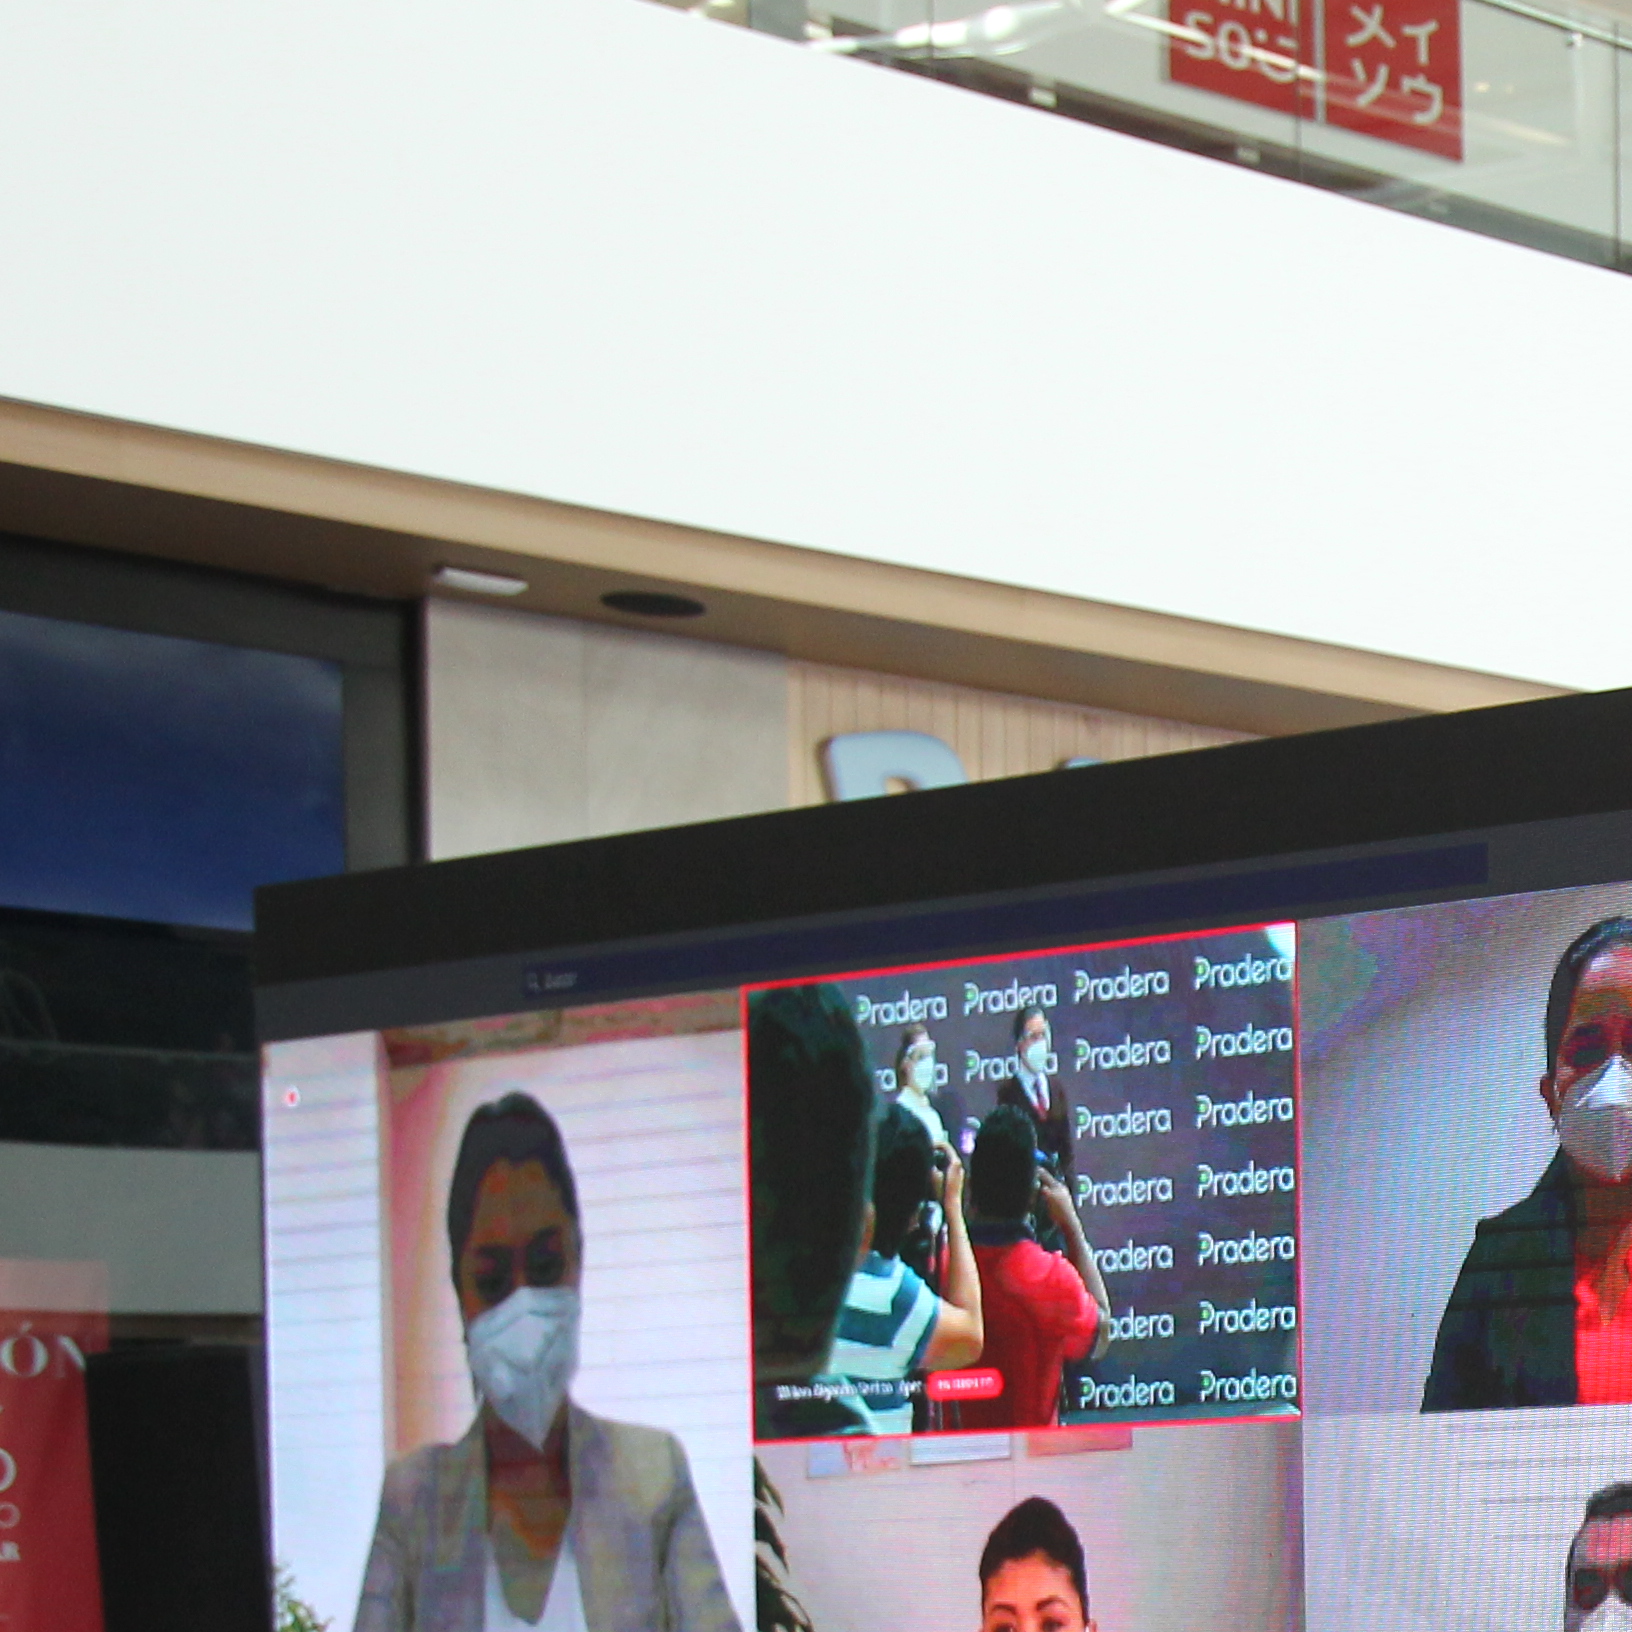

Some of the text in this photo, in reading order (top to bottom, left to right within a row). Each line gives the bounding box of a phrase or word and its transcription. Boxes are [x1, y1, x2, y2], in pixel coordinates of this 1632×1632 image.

[964, 978, 1058, 1017] Pradera
[1074, 964, 1170, 1004] Pradera
[856, 989, 948, 1025] Pradera
[1075, 1034, 1171, 1072] Pradera
[1196, 1023, 1293, 1060] Pradera
[1076, 1102, 1172, 1140] Pradera
[1197, 1090, 1294, 1129] Pradera
[1076, 1170, 1174, 1208] Pradera
[1198, 1160, 1295, 1198] Pradera
[1090, 1239, 1174, 1273] radera
[1199, 1230, 1296, 1266] Pradera
[1108, 1306, 1175, 1341] adera
[1200, 1298, 1296, 1335] Pradera
[1079, 1374, 1175, 1408] Pradera
[1201, 1367, 1297, 1402] Pradera
